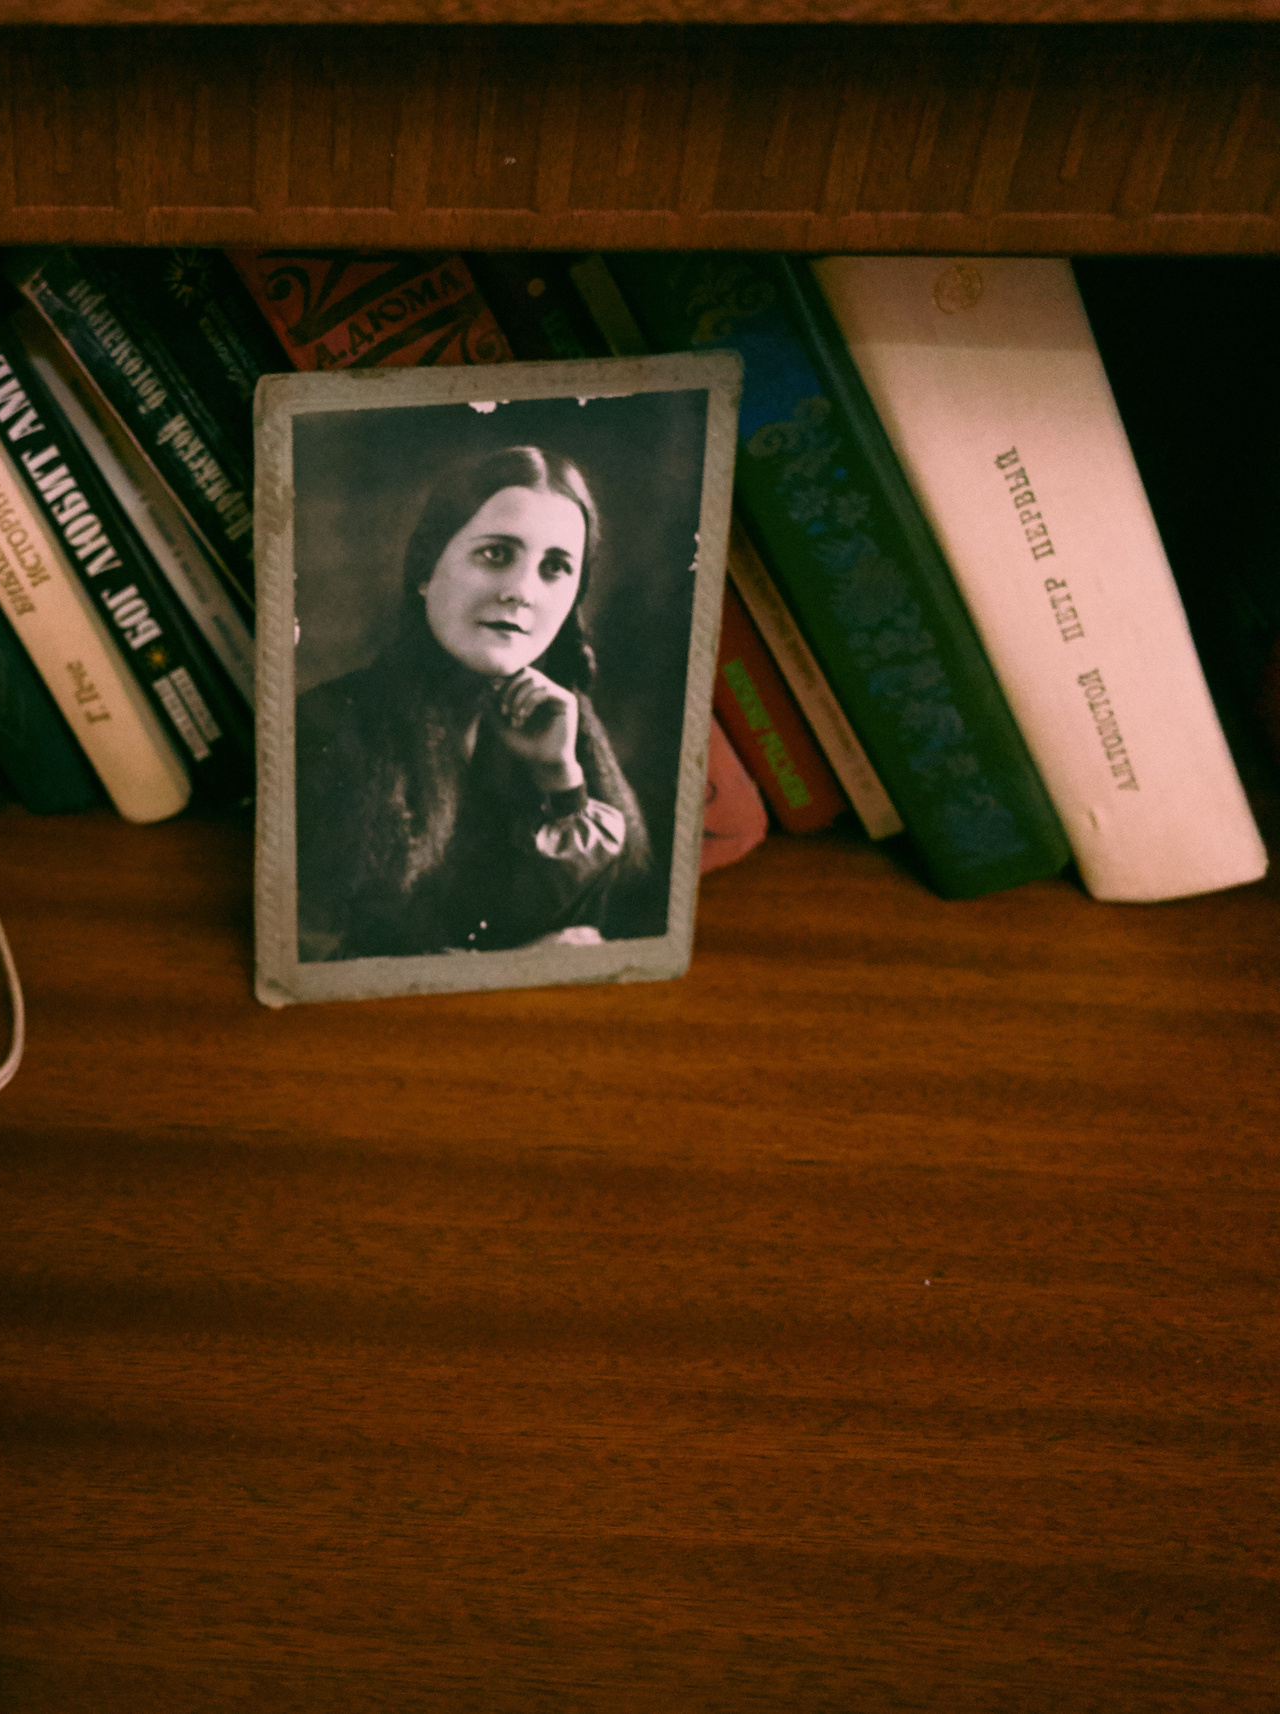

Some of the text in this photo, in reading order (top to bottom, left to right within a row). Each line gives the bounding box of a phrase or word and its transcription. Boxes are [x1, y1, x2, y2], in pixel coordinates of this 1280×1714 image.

[18, 442, 124, 581] ЛЮБИТ
[992, 444, 1056, 562] ПЕРВЫЙ
[99, 577, 164, 651] БОГ
[1042, 575, 1085, 644] ПЕТР
